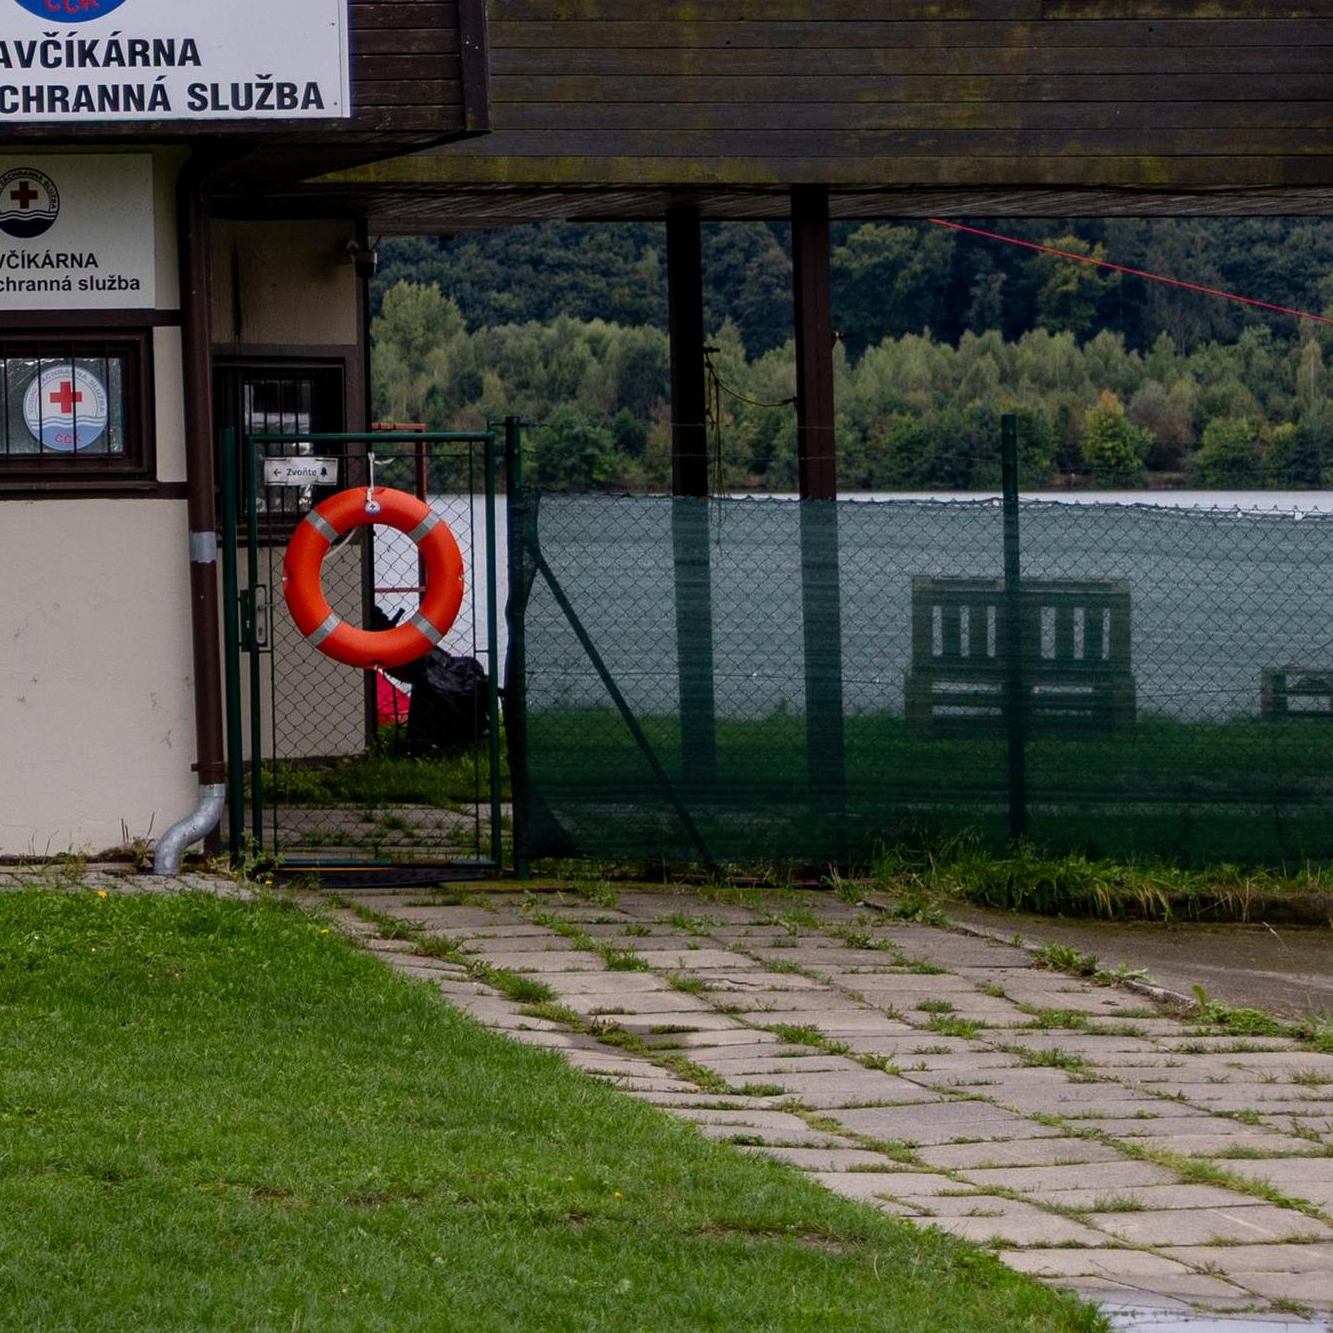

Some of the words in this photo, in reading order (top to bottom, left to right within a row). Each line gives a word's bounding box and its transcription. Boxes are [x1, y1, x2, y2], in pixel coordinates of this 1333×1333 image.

[187, 73, 325, 111] SLUŽBA
[78, 274, 140, 291] služba
[286, 467, 318, 477] Zvoňte
